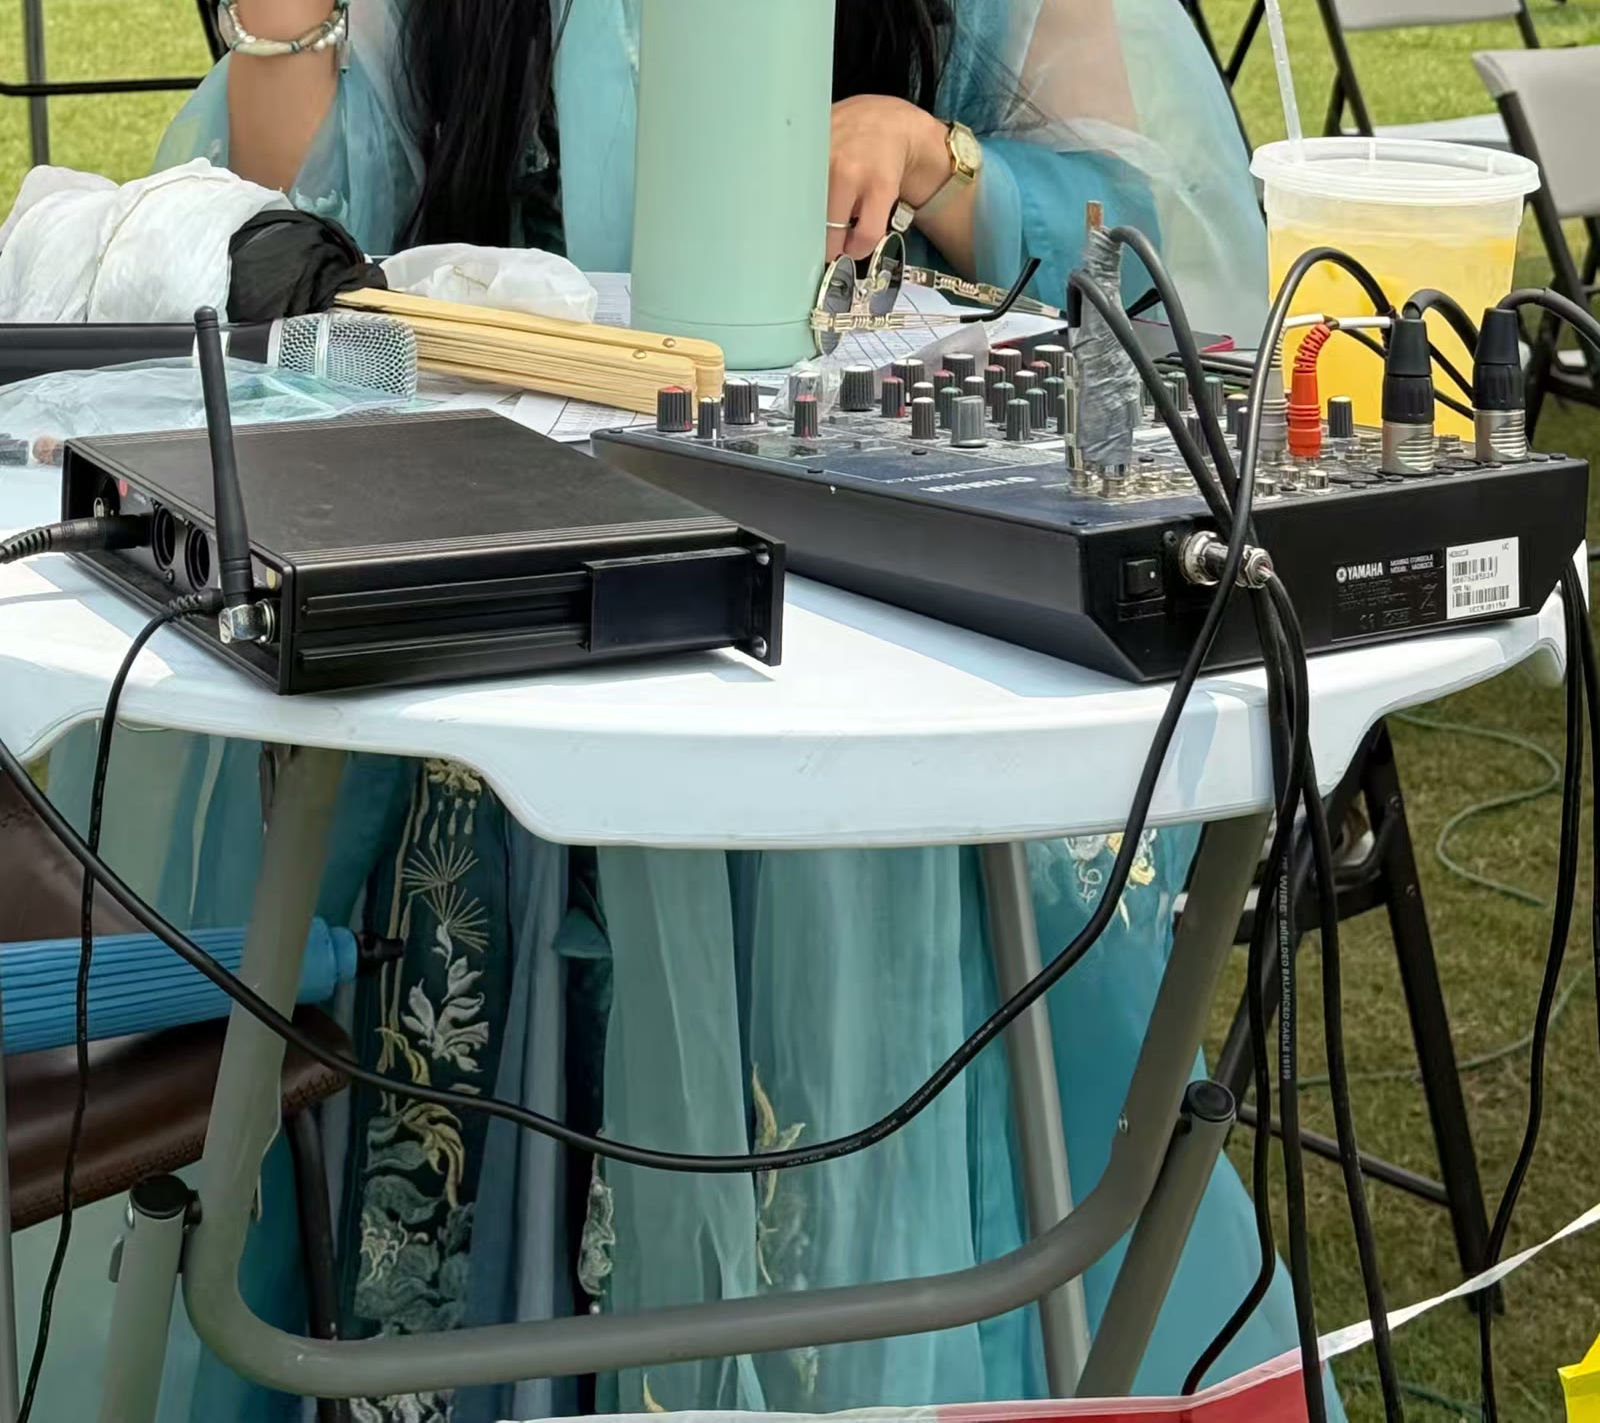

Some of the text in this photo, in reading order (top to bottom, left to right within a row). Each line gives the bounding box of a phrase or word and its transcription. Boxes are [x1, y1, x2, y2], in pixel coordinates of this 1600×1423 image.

[1347, 562, 1384, 581] YAMAHA
[1279, 919, 1290, 967] SHIELDED
[1281, 968, 1291, 1020] BALANCED
[1281, 1020, 1291, 1052] CABLE
